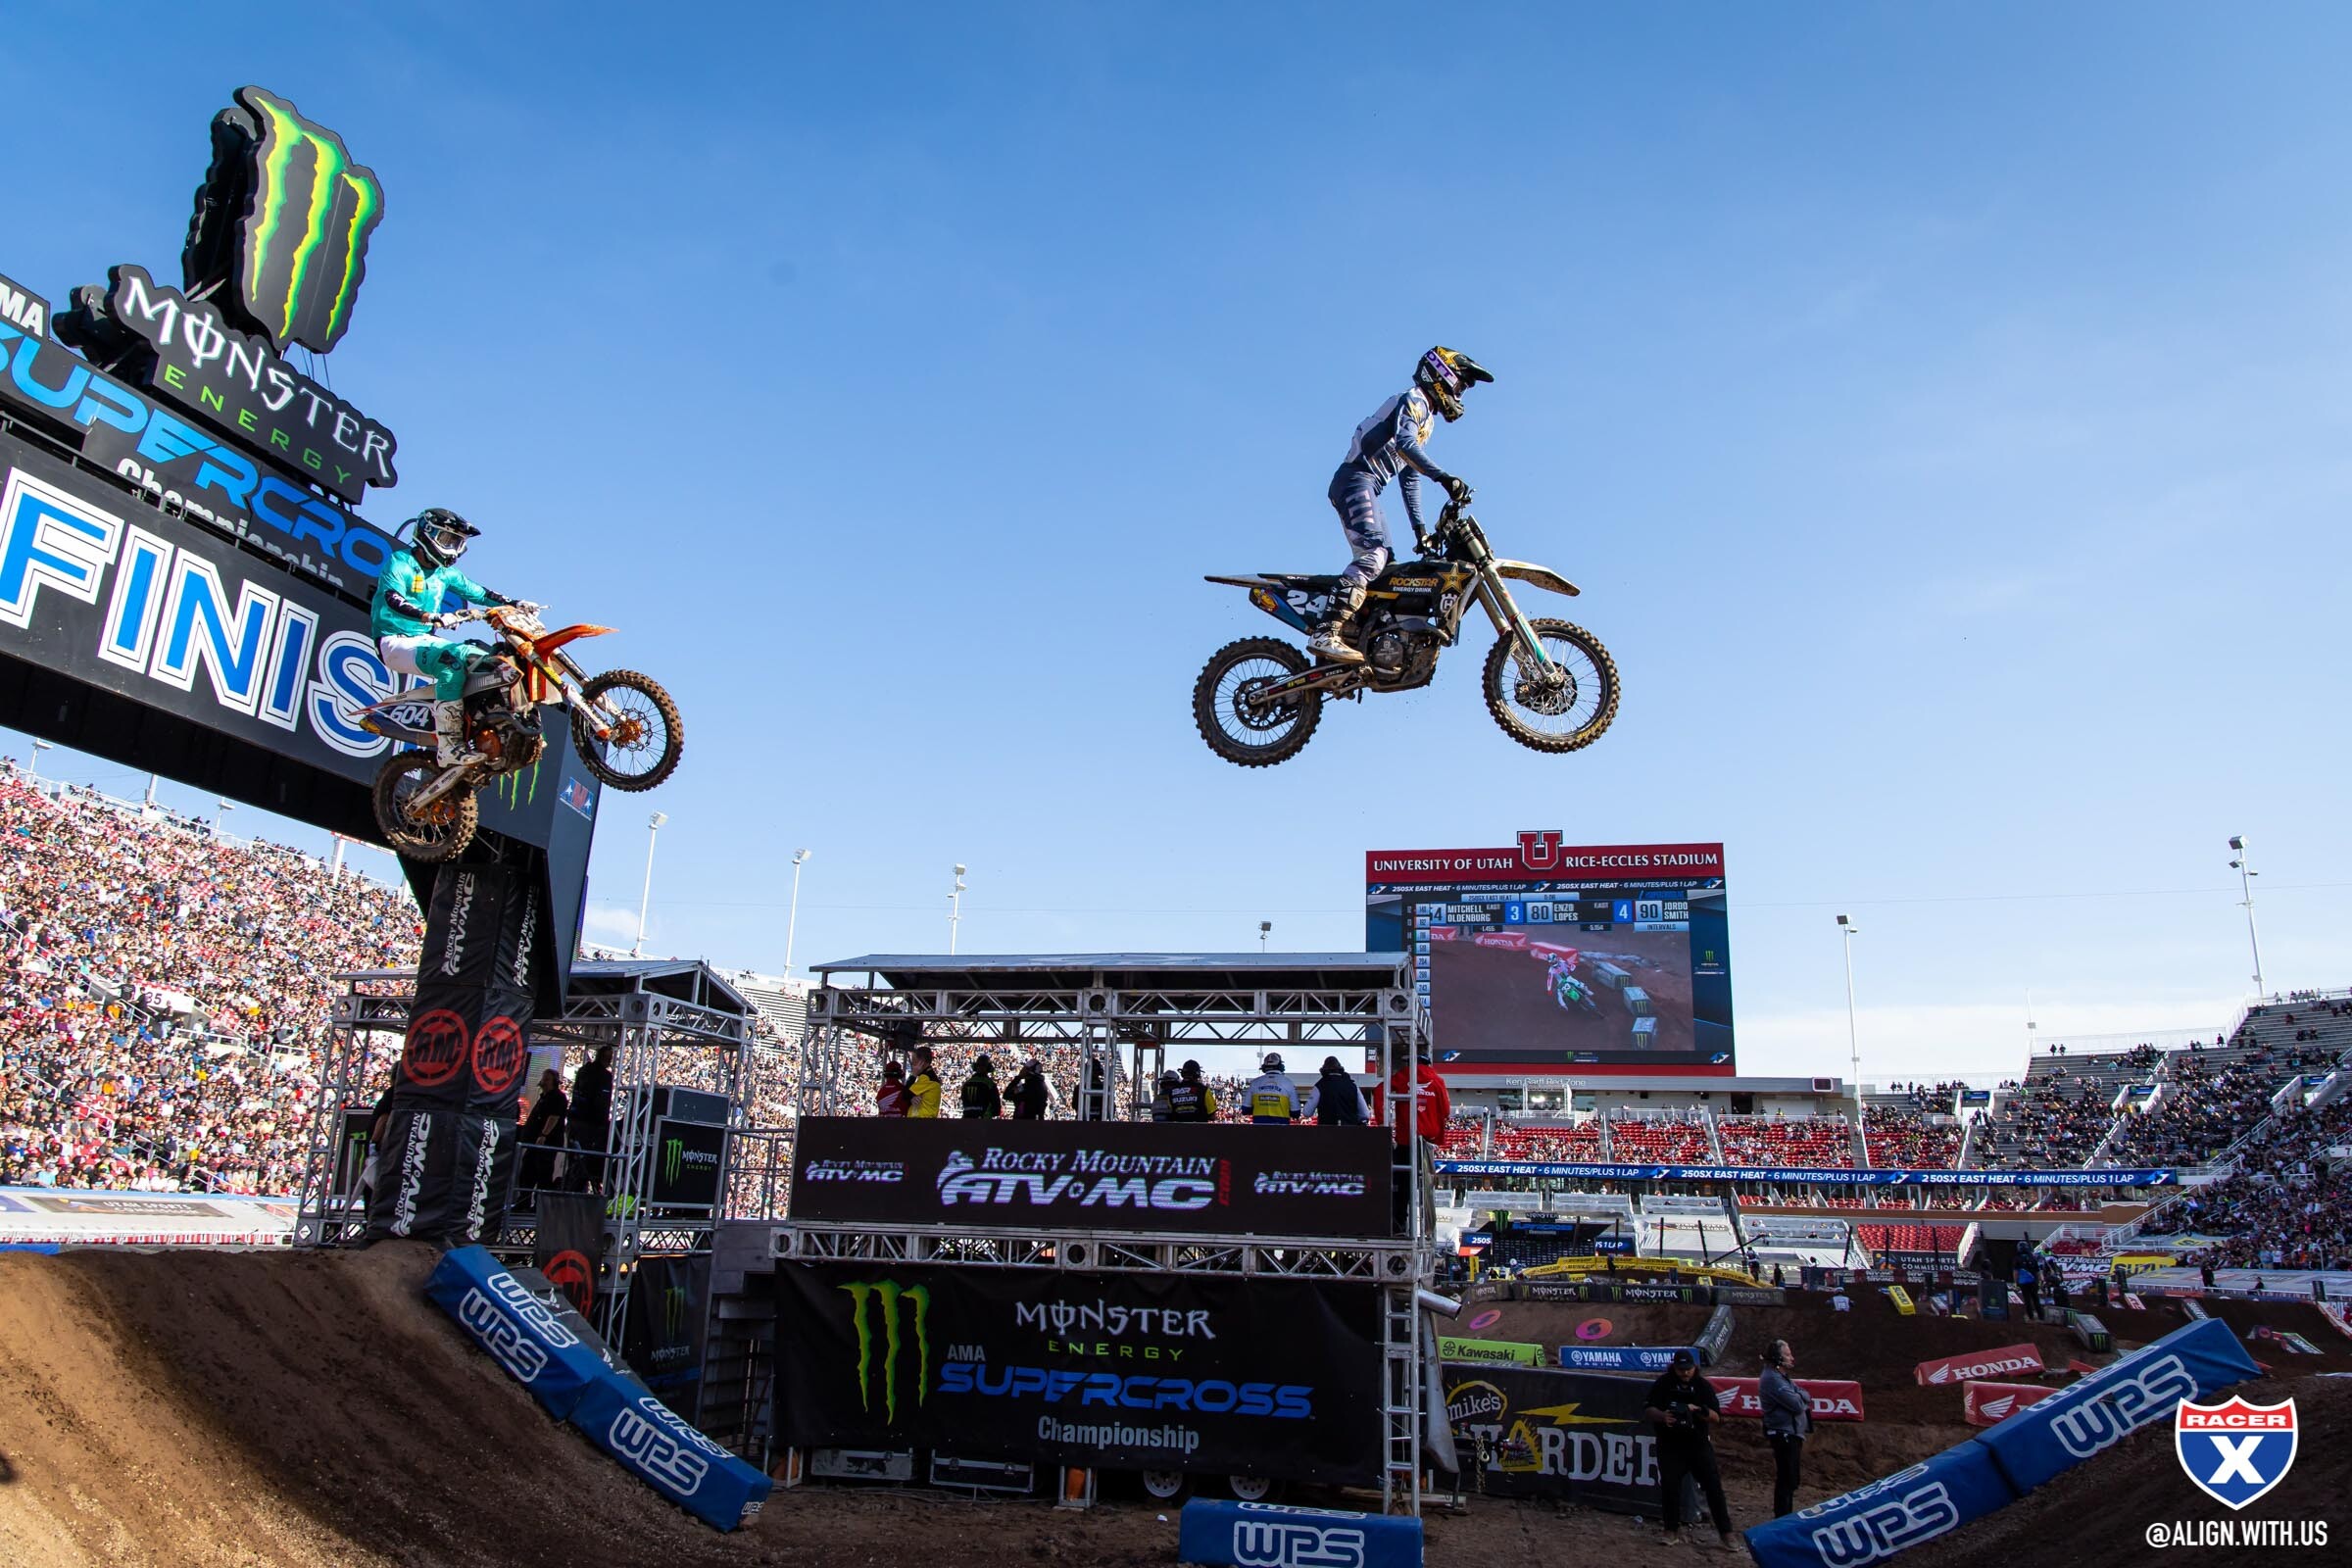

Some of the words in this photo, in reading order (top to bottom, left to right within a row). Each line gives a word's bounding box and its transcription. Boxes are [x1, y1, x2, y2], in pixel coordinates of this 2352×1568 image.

[123, 275, 390, 479] MONSTER
[164, 364, 351, 484] ENERGY
[1389, 577, 1439, 587] ROCKSTAR
[391, 706, 429, 727] 604
[1374, 859, 1450, 871] UNIVERSITY
[1454, 858, 1472, 870] OF
[1477, 858, 1513, 870] UTAH
[1565, 856, 1649, 868] RICE-ECCLES
[1653, 854, 1718, 866] STADIUM
[450, 872, 466, 925] MOUNTAIN
[1447, 905, 1483, 913] MITCHELL
[1447, 913, 1491, 922] OLDENBURG
[1510, 906, 1519, 921] 3
[1531, 906, 1549, 920] 80
[1554, 912, 1579, 921] LOPES
[1619, 904, 1628, 919] 4
[1640, 904, 1658, 919] 90
[1664, 910, 1689, 920] SMITH
[445, 927, 457, 958] ROCKY
[1484, 938, 1513, 947] HONDA
[514, 937, 525, 970] ROCKY
[1566, 1078, 1586, 1087] Zone
[402, 1112, 421, 1176] MOUNTAIN
[682, 1150, 717, 1164] MONSTER
[983, 1148, 1065, 1171] ROCKY
[1070, 1150, 1215, 1175] MOUNTAIN
[467, 1183, 481, 1221] ROCKY
[474, 1118, 491, 1181] MOUNTAIN
[1457, 1164, 1487, 1173] 250SX
[1512, 1165, 1537, 1174] HEAT
[1551, 1166, 1615, 1176] MINUTES/PLUS
[1682, 1169, 1711, 1178] 250SX
[1740, 1170, 1766, 1179] HEAT
[1782, 1172, 1849, 1181] MINUTES/PLUS
[1857, 1173, 1876, 1182] LAP
[1922, 1174, 1956, 1183] 250SX
[1959, 1174, 1986, 1183] EAST
[1988, 1174, 2016, 1183] HEAT
[2024, 1174, 2031, 1183] 6
[2033, 1174, 2106, 1183] MINUTES/PLUS
[2114, 1174, 2134, 1183] LAP
[103, 1200, 140, 1209] UTAH
[145, 1201, 191, 1211] SPORTS
[395, 1178, 410, 1217] ROCKY
[1533, 1286, 1576, 1296] MONSTER
[1626, 1289, 1678, 1298] MONSTER
[1733, 1291, 1771, 1299] MONSTER
[487, 1272, 579, 1348] WPS
[1015, 1297, 1216, 1340] MONSTER
[459, 1288, 548, 1383] WPS
[651, 1345, 690, 1361] MONSTER
[947, 1344, 986, 1362] AMA
[1048, 1340, 1184, 1361] ENERGY
[1457, 1346, 1515, 1361] Kawasaki
[1581, 1351, 1622, 1363] YAMAHA
[1951, 1356, 2041, 1380] HONDA
[937, 1362, 1315, 1420] SUPERCROSS
[1446, 1393, 1501, 1421] mike's
[1740, 1395, 1859, 1415] HDA
[2050, 1354, 2198, 1458] WPS
[1038, 1415, 1200, 1454] Championship
[609, 1406, 710, 1496] WPS
[1813, 1482, 1959, 1568] WPS
[1234, 1521, 1365, 1568] WPS
